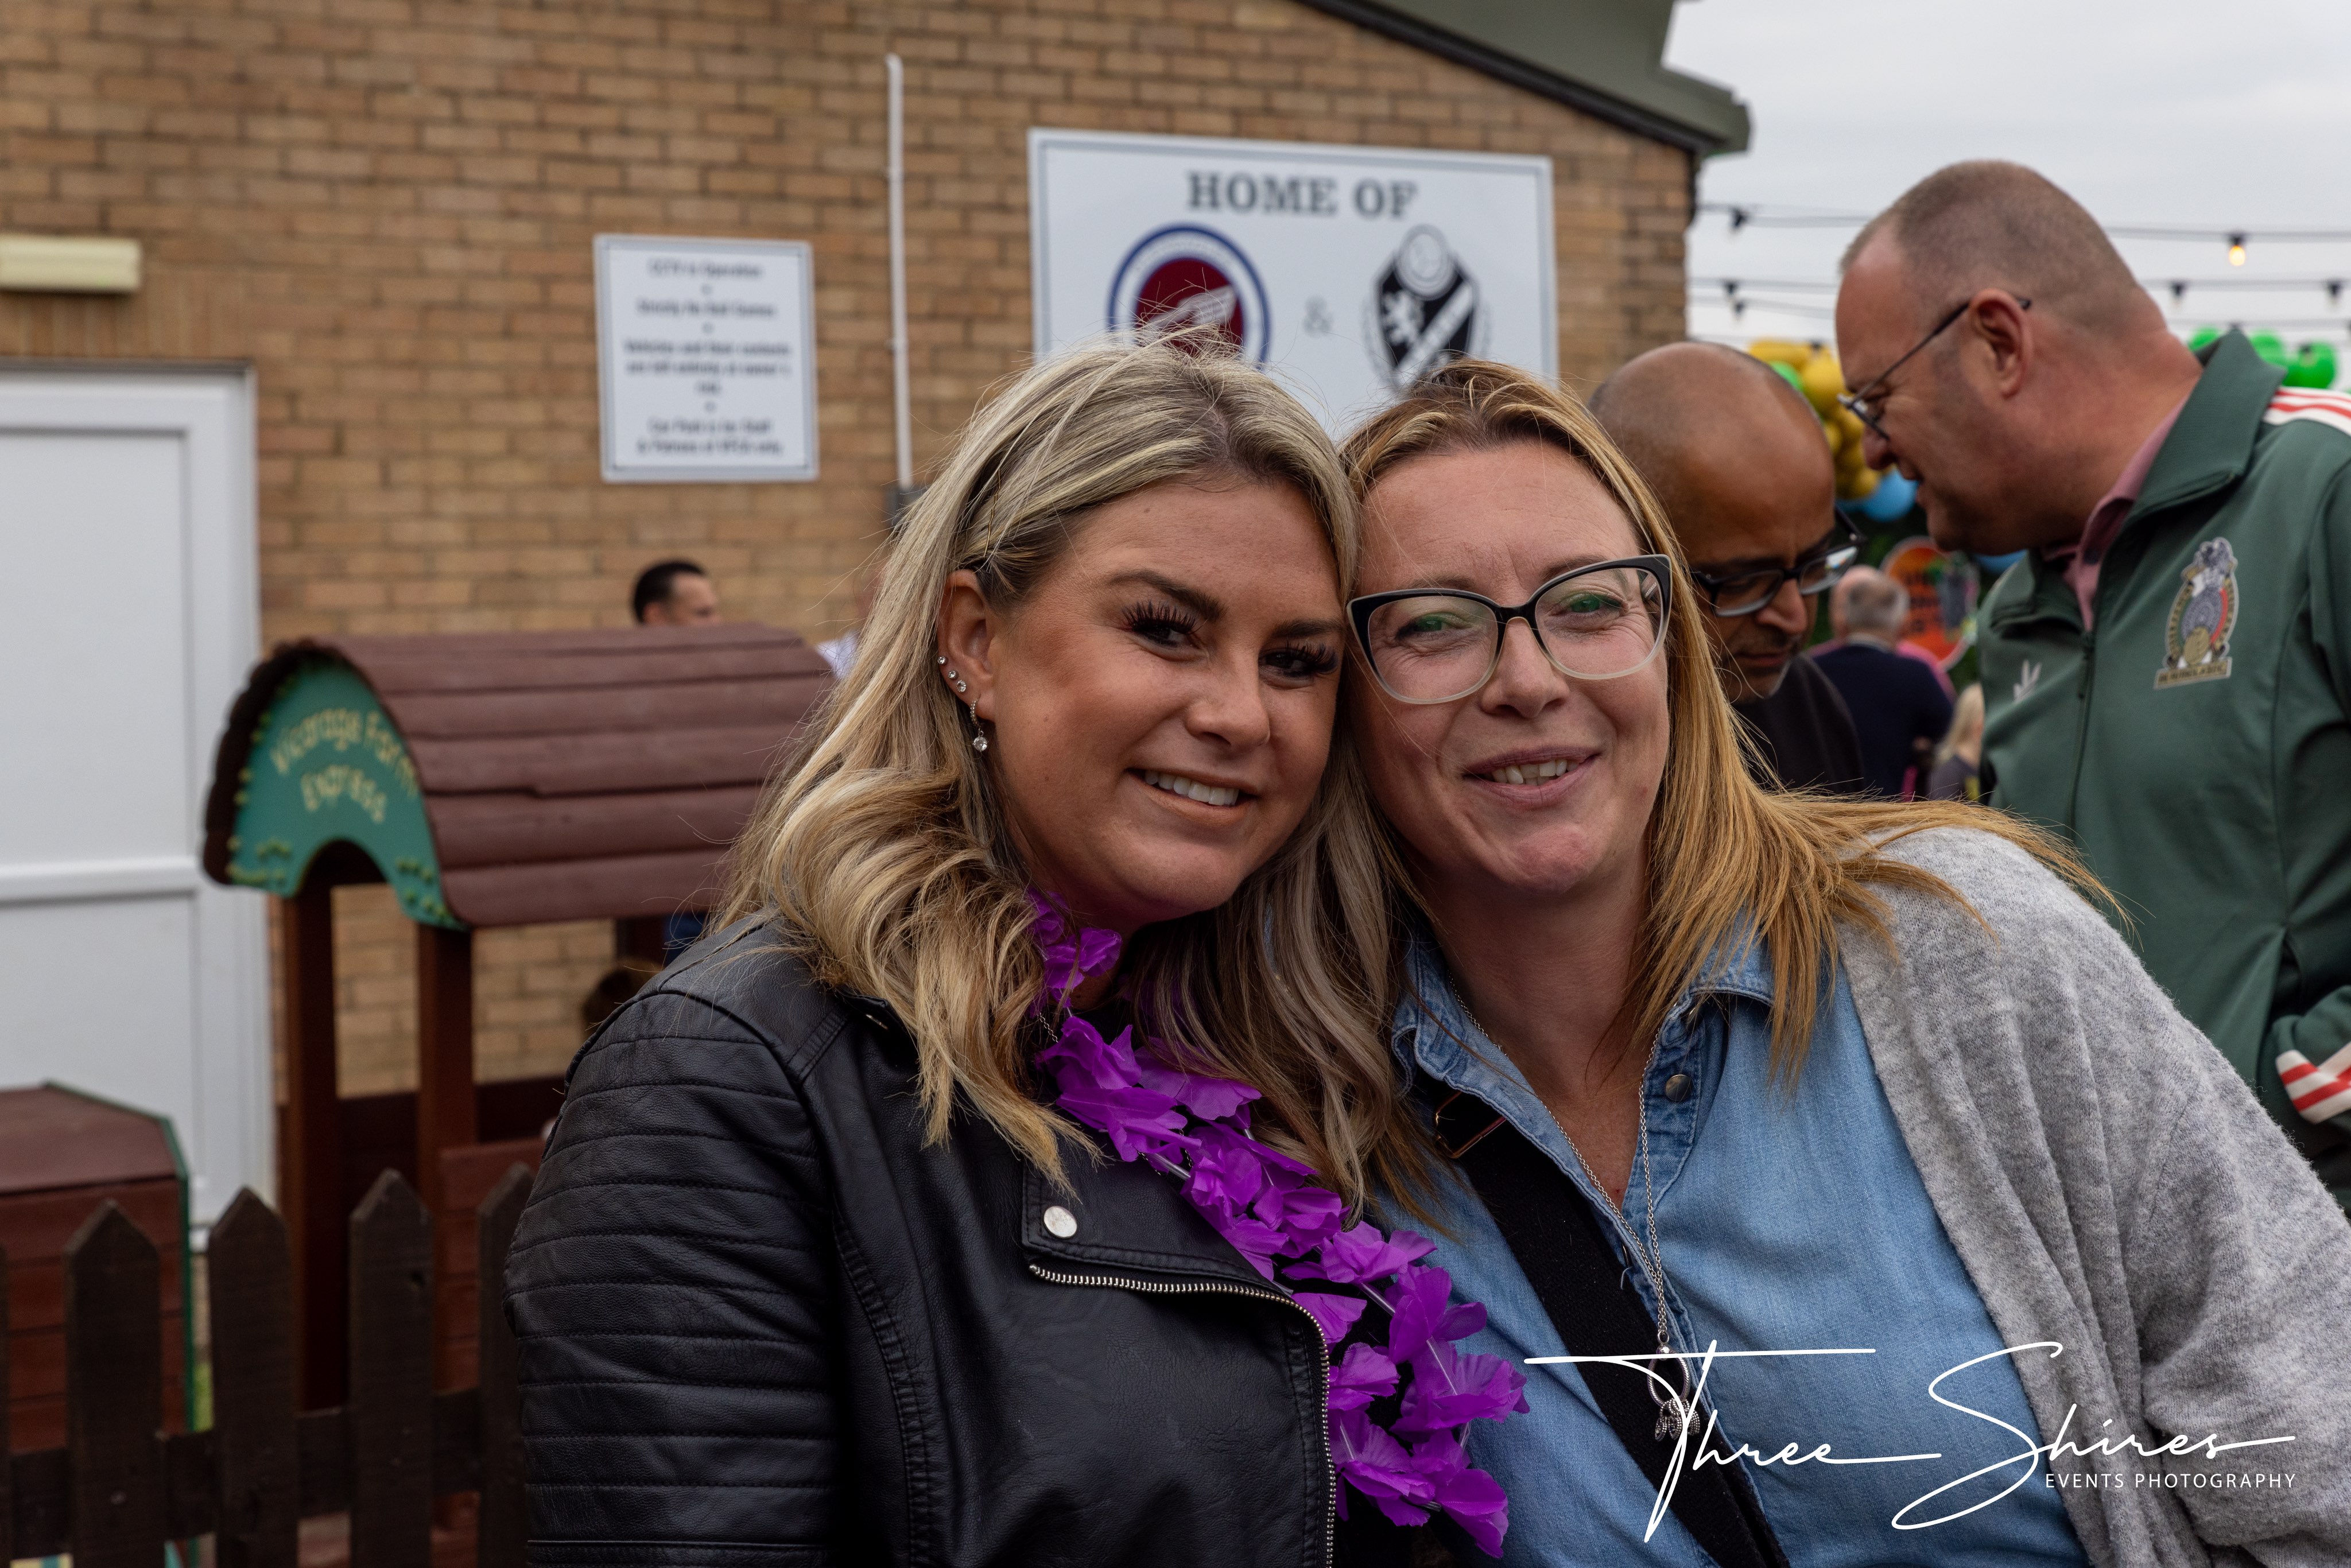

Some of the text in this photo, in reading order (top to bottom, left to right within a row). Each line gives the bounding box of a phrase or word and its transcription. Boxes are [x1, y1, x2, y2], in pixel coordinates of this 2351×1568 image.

[1186, 170, 1418, 220] HOME OF
[1303, 295, 1333, 337] &
[270, 708, 362, 775] Vicarage
[301, 764, 386, 822] Express
